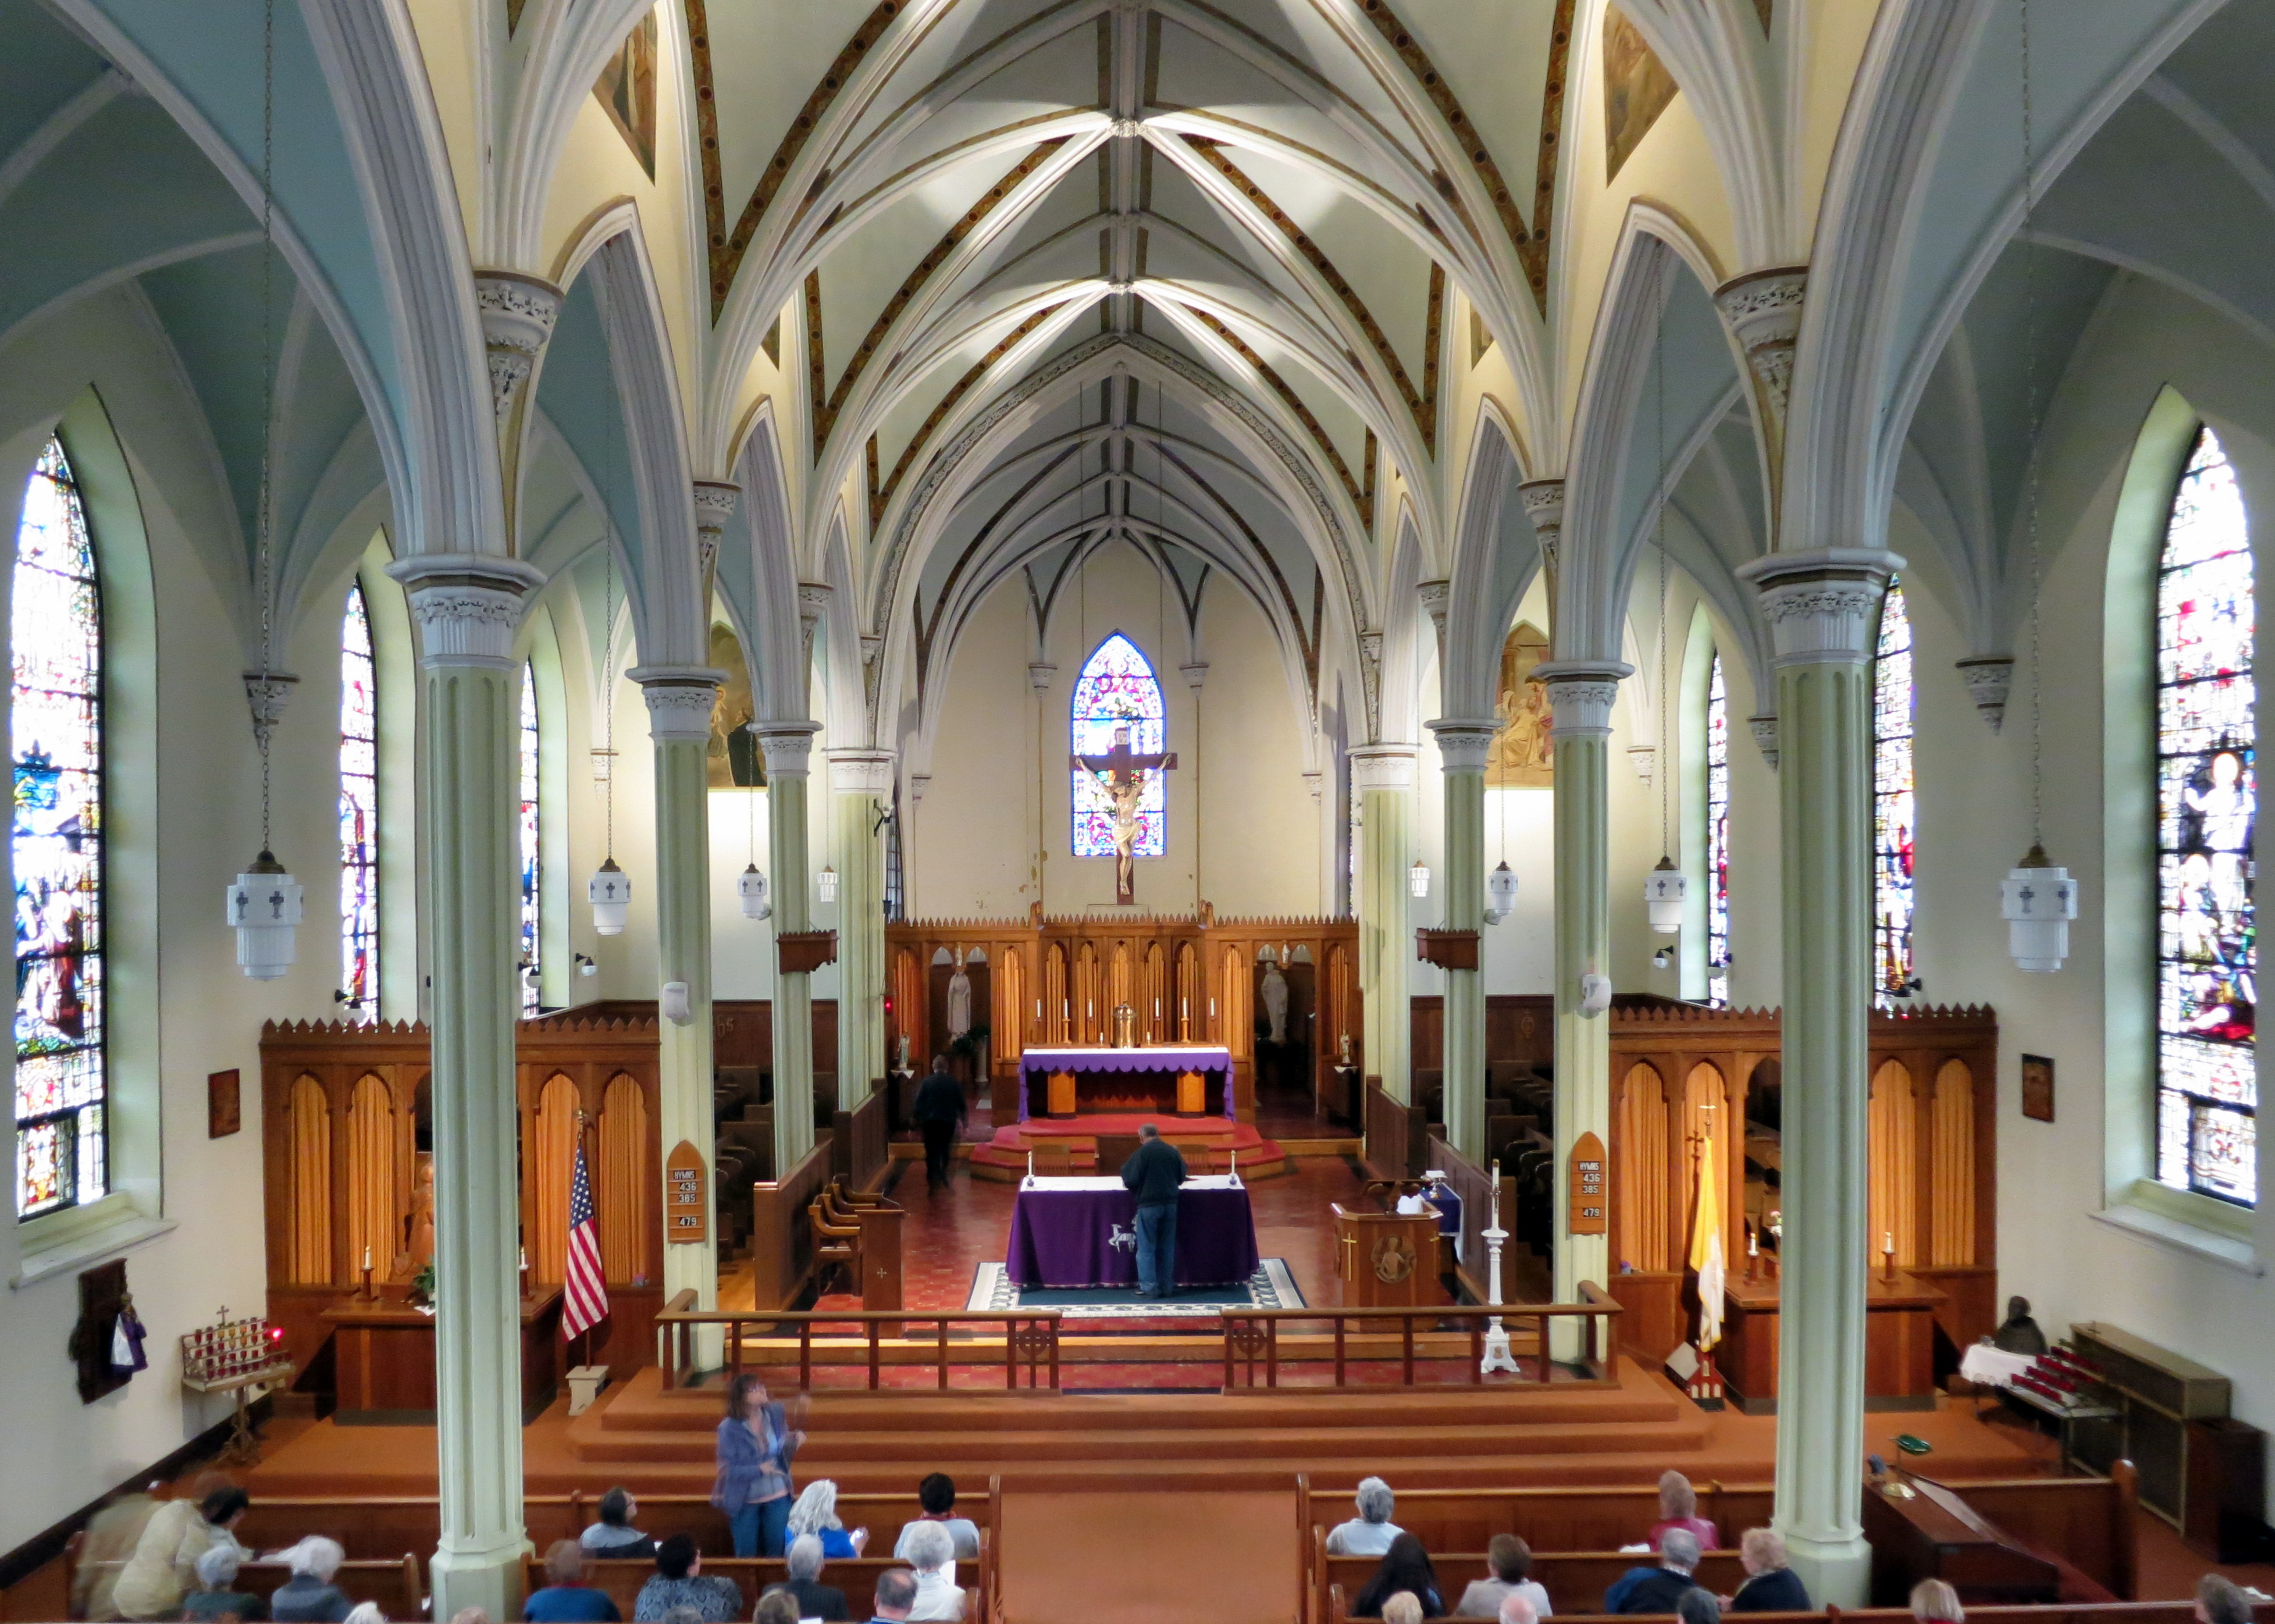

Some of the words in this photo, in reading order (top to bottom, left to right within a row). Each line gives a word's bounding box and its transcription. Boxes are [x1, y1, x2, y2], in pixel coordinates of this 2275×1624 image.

[1579, 1162, 1599, 1170] HYMNS
[674, 1170, 695, 1180] HYMNS
[1583, 1173, 1600, 1182] 436
[679, 1182, 696, 1191] 436
[1583, 1185, 1598, 1194] 385
[679, 1194, 696, 1203] 385
[1583, 1208, 1600, 1217] 479
[679, 1217, 697, 1226] 479
